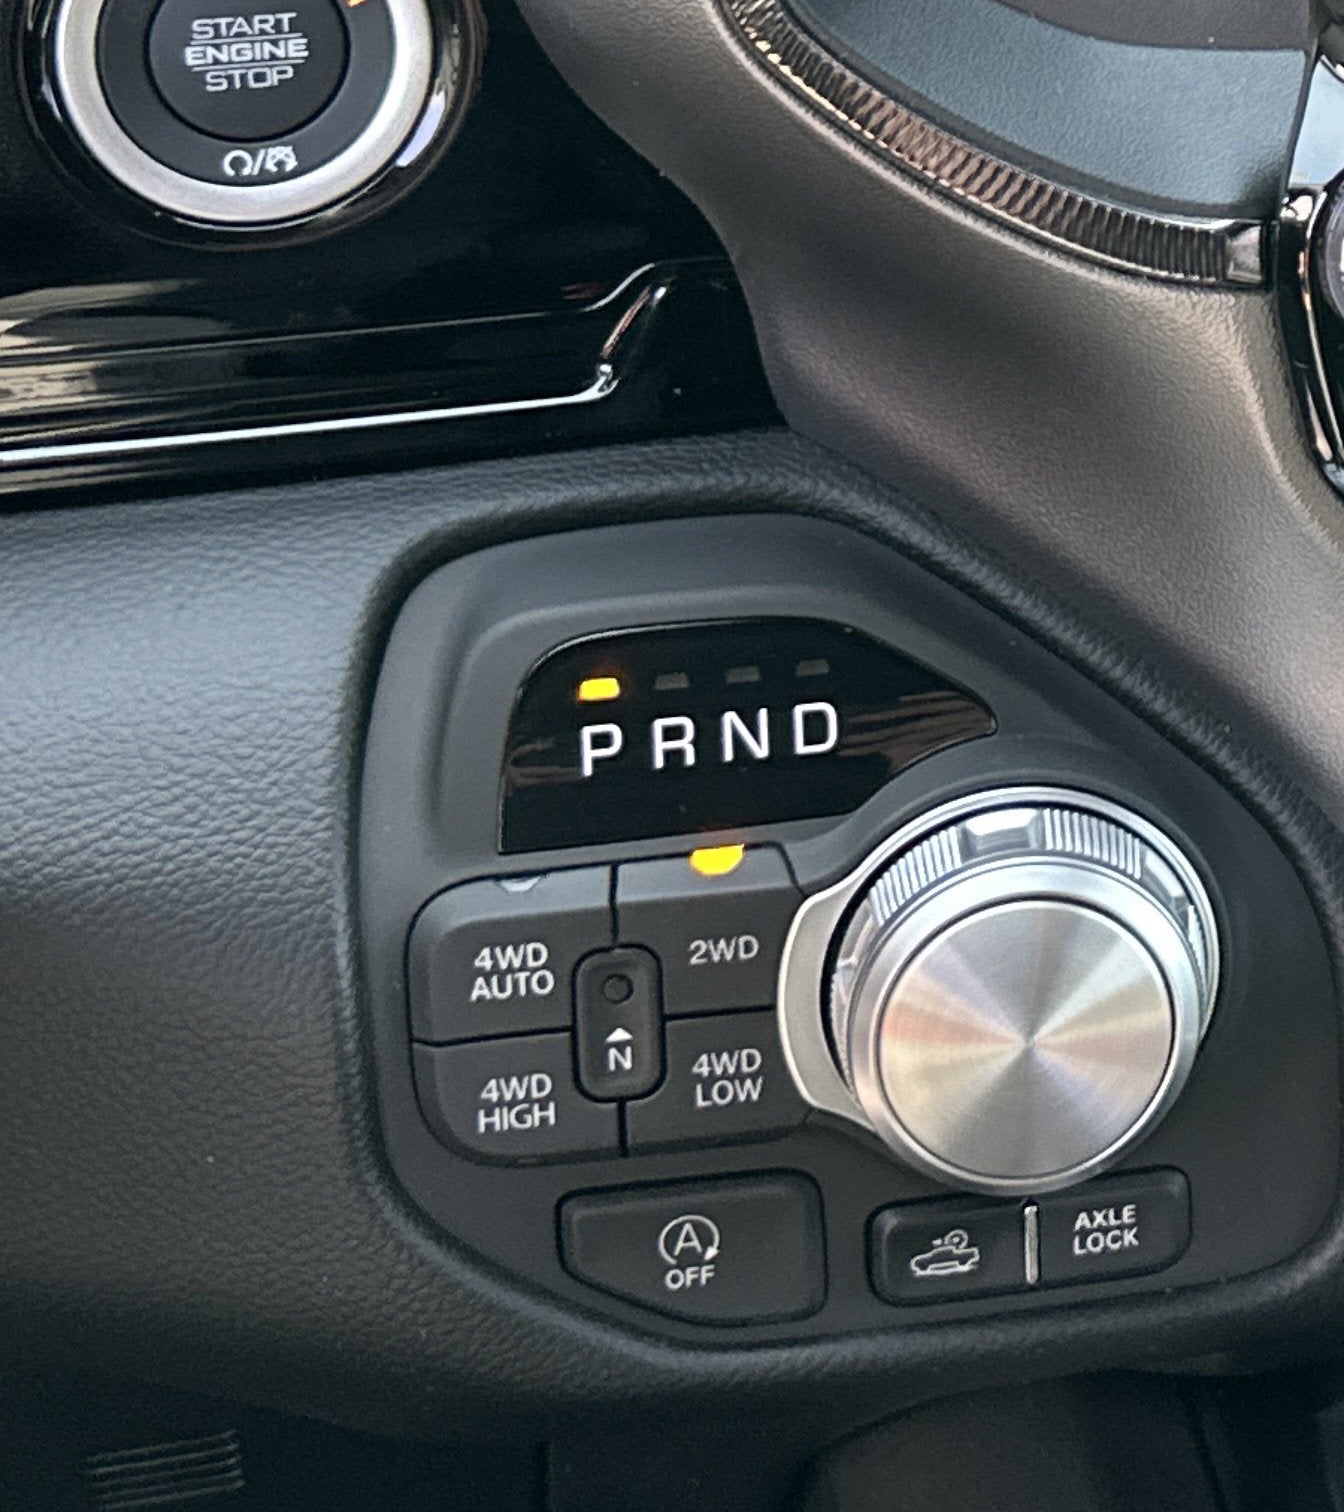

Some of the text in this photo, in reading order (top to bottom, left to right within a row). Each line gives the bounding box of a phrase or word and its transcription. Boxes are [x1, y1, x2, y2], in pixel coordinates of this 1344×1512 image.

[192, 12, 298, 39] START
[185, 39, 309, 67] ENGINE
[205, 66, 295, 92] STOP
[581, 702, 838, 777] P R N D
[473, 943, 548, 972] 4WD
[689, 935, 759, 964] 2WD
[470, 970, 554, 1001] AUTO
[609, 1046, 633, 1071] N
[692, 1048, 762, 1079] 4WD
[480, 1073, 552, 1104] 4WD
[694, 1076, 764, 1108] LOW
[477, 1101, 557, 1134] HIGH
[1073, 1204, 1137, 1231] AXLE
[1073, 1224, 1139, 1255] LOCK
[665, 1264, 716, 1290] OFF
